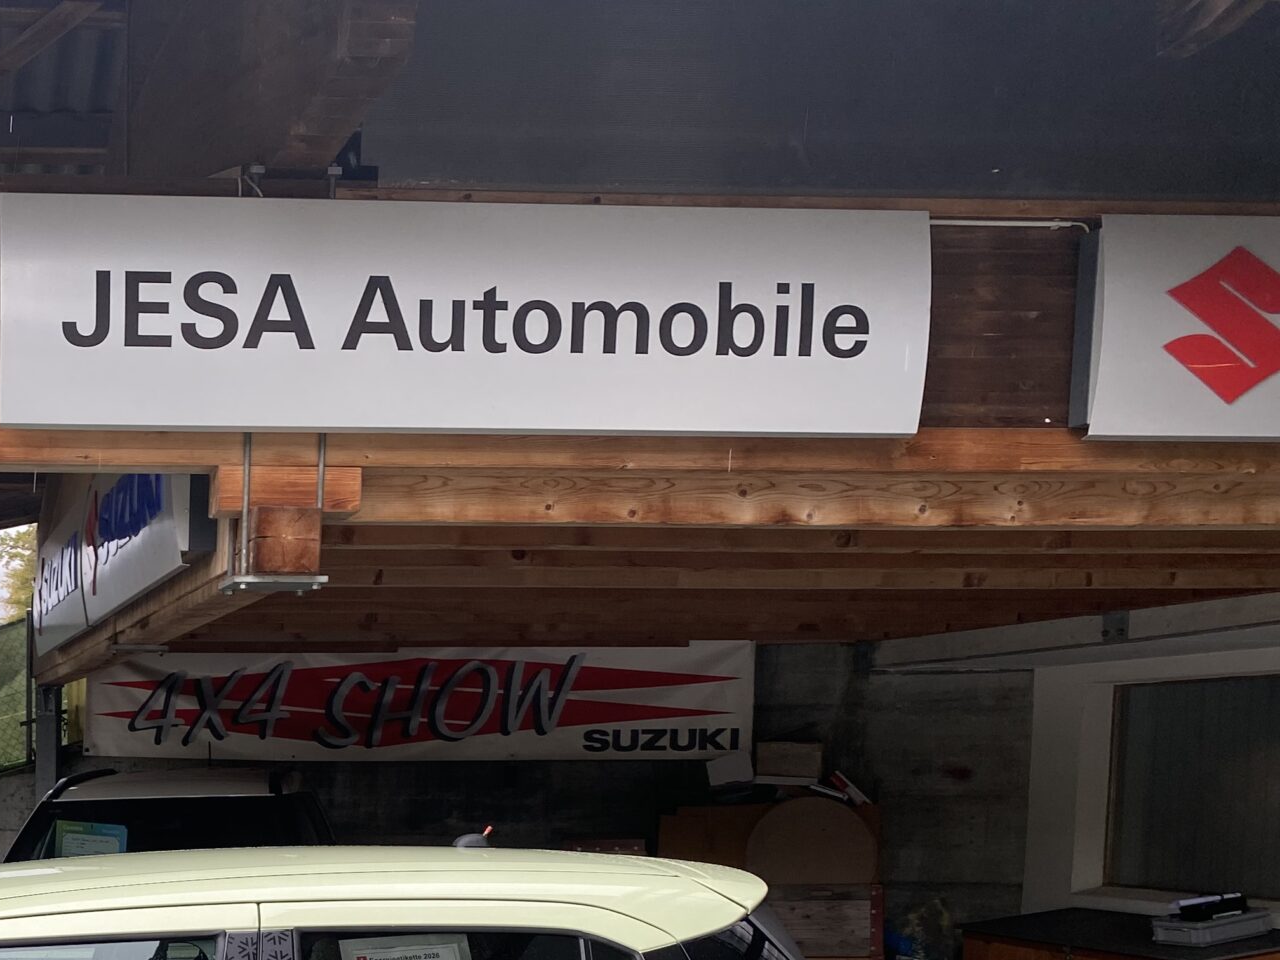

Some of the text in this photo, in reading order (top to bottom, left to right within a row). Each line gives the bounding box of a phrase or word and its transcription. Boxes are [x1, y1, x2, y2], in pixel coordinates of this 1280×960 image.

[60, 269, 872, 360] JESA Automobile
[312, 652, 587, 749] SHOW
[582, 726, 740, 753] SUZUKI
